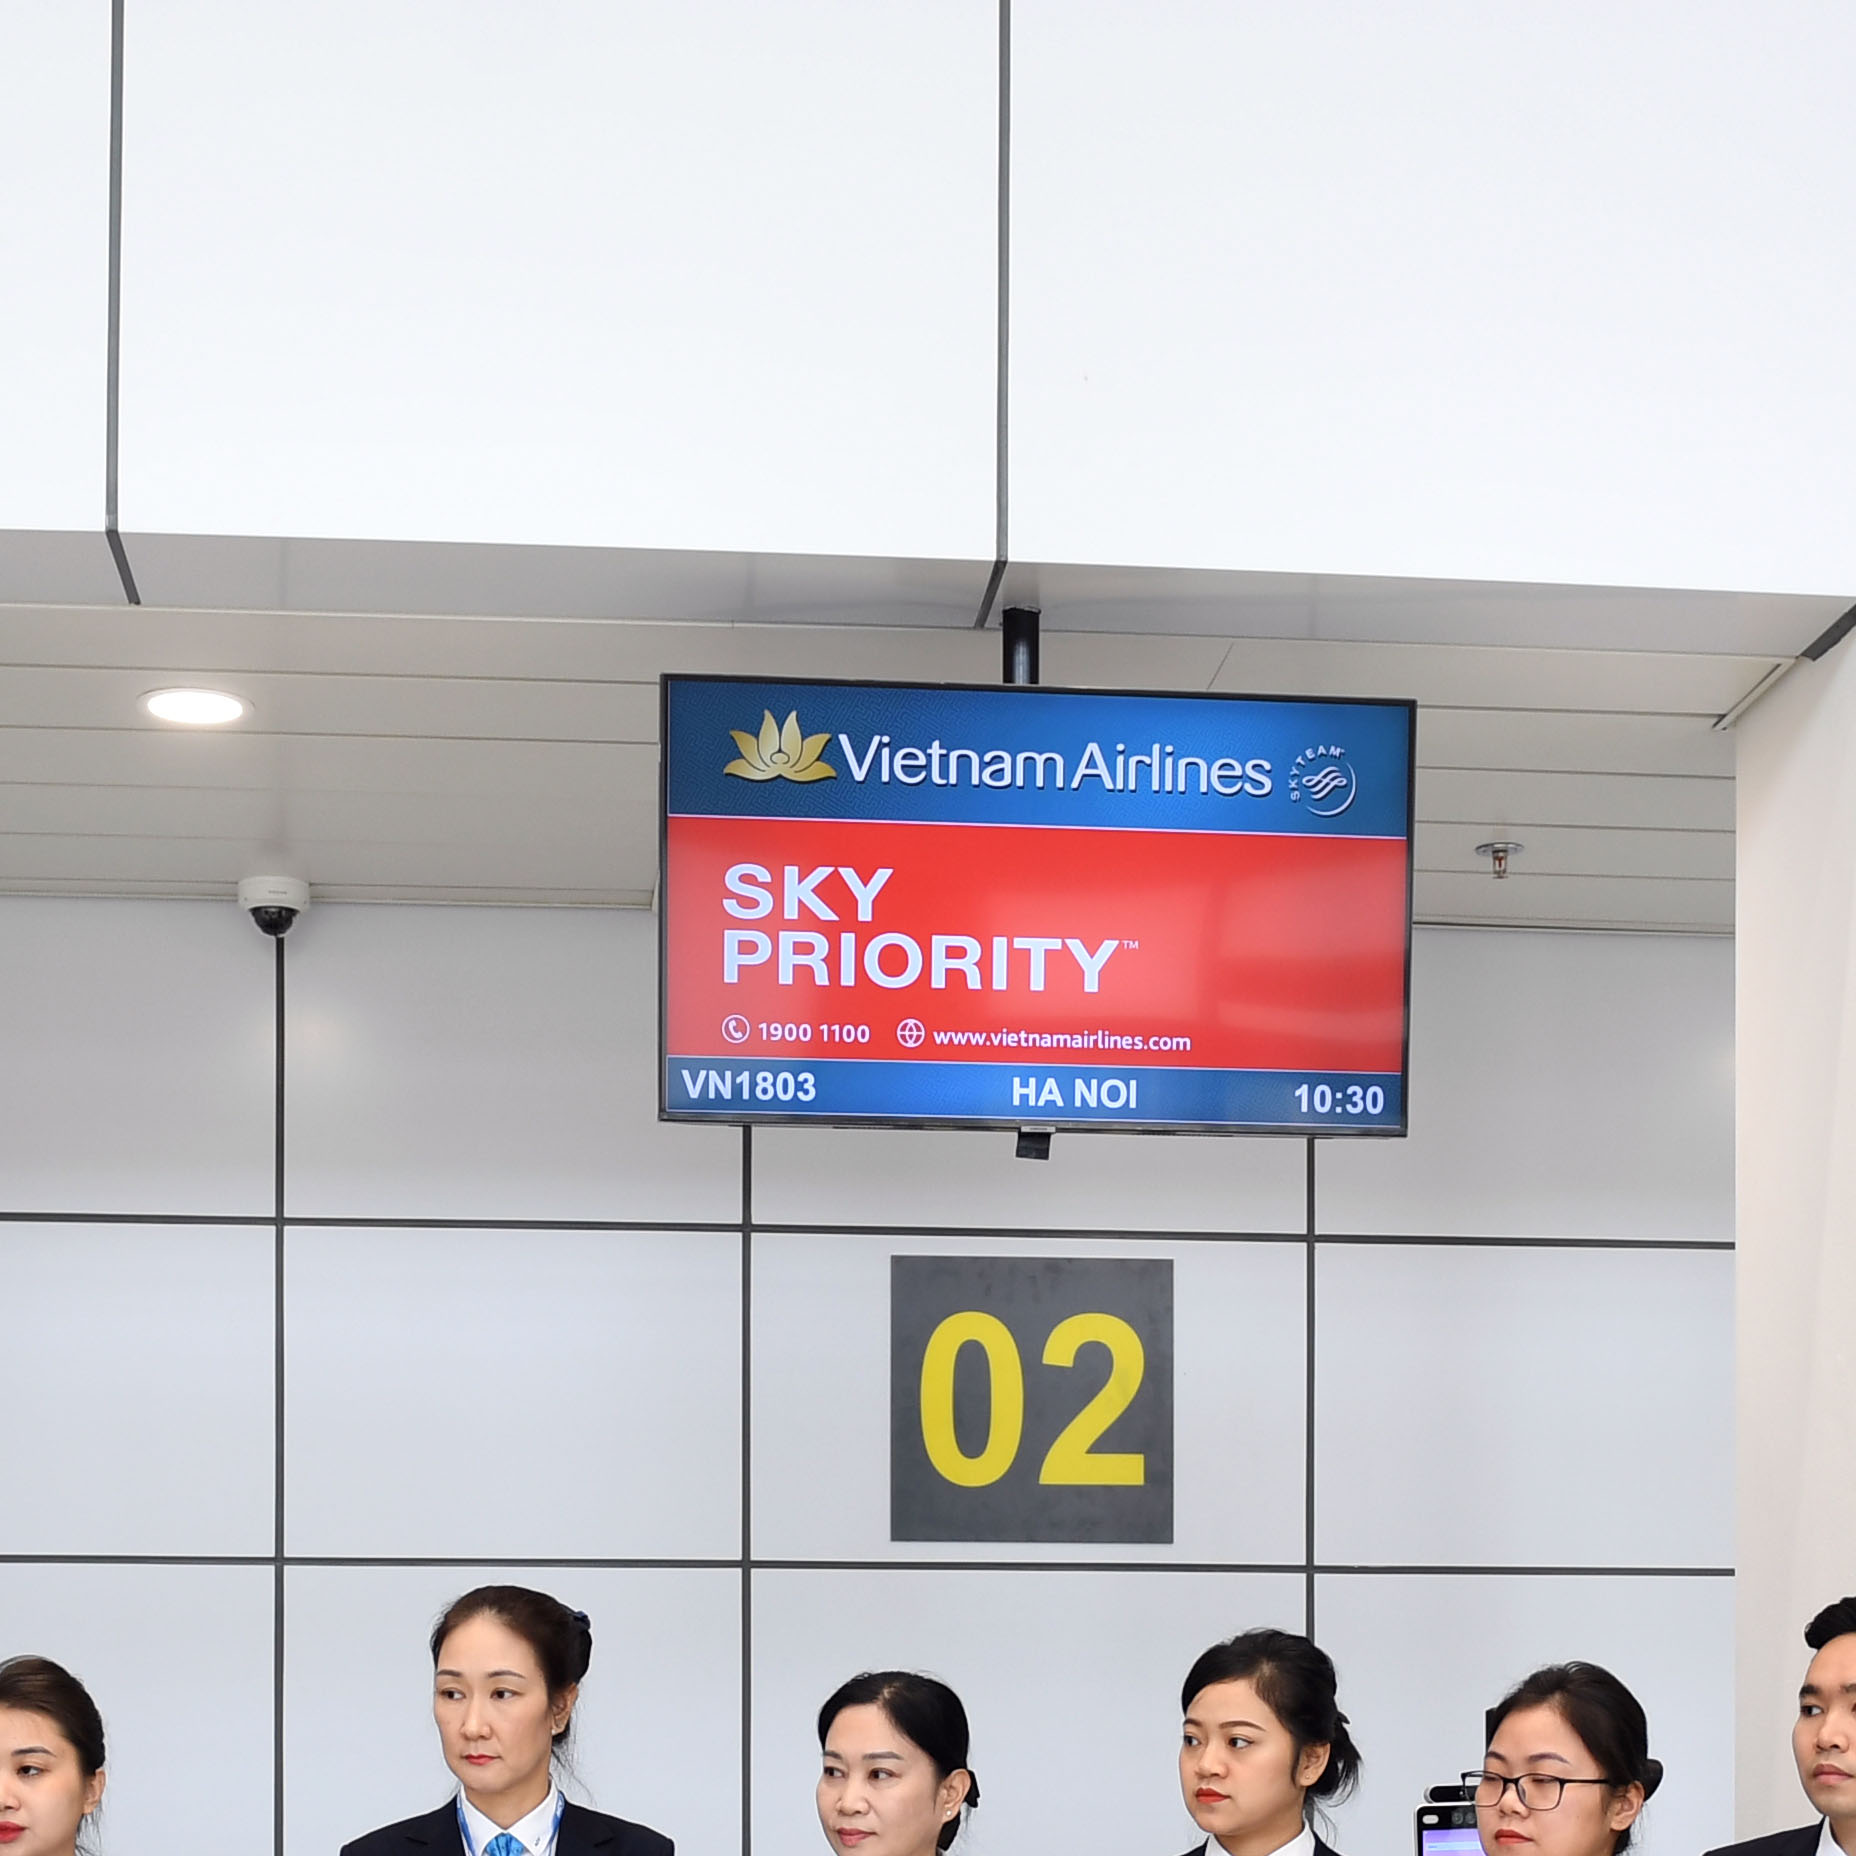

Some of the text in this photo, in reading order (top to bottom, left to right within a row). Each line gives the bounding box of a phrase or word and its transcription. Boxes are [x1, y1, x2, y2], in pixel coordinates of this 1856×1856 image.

[838, 733, 1273, 796] Vietnam Airlines
[1288, 745, 1341, 801] SKYTEAM
[722, 863, 894, 922] SKY
[723, 929, 1120, 993] PRIORITY
[758, 1022, 870, 1044] 1900 1100
[933, 1028, 1192, 1052] www.vietnamairlines.com
[681, 1069, 817, 1102] VN1803
[1012, 1077, 1137, 1110] HA NOI
[1294, 1083, 1385, 1116] 10:30
[920, 1310, 1145, 1488] 02
